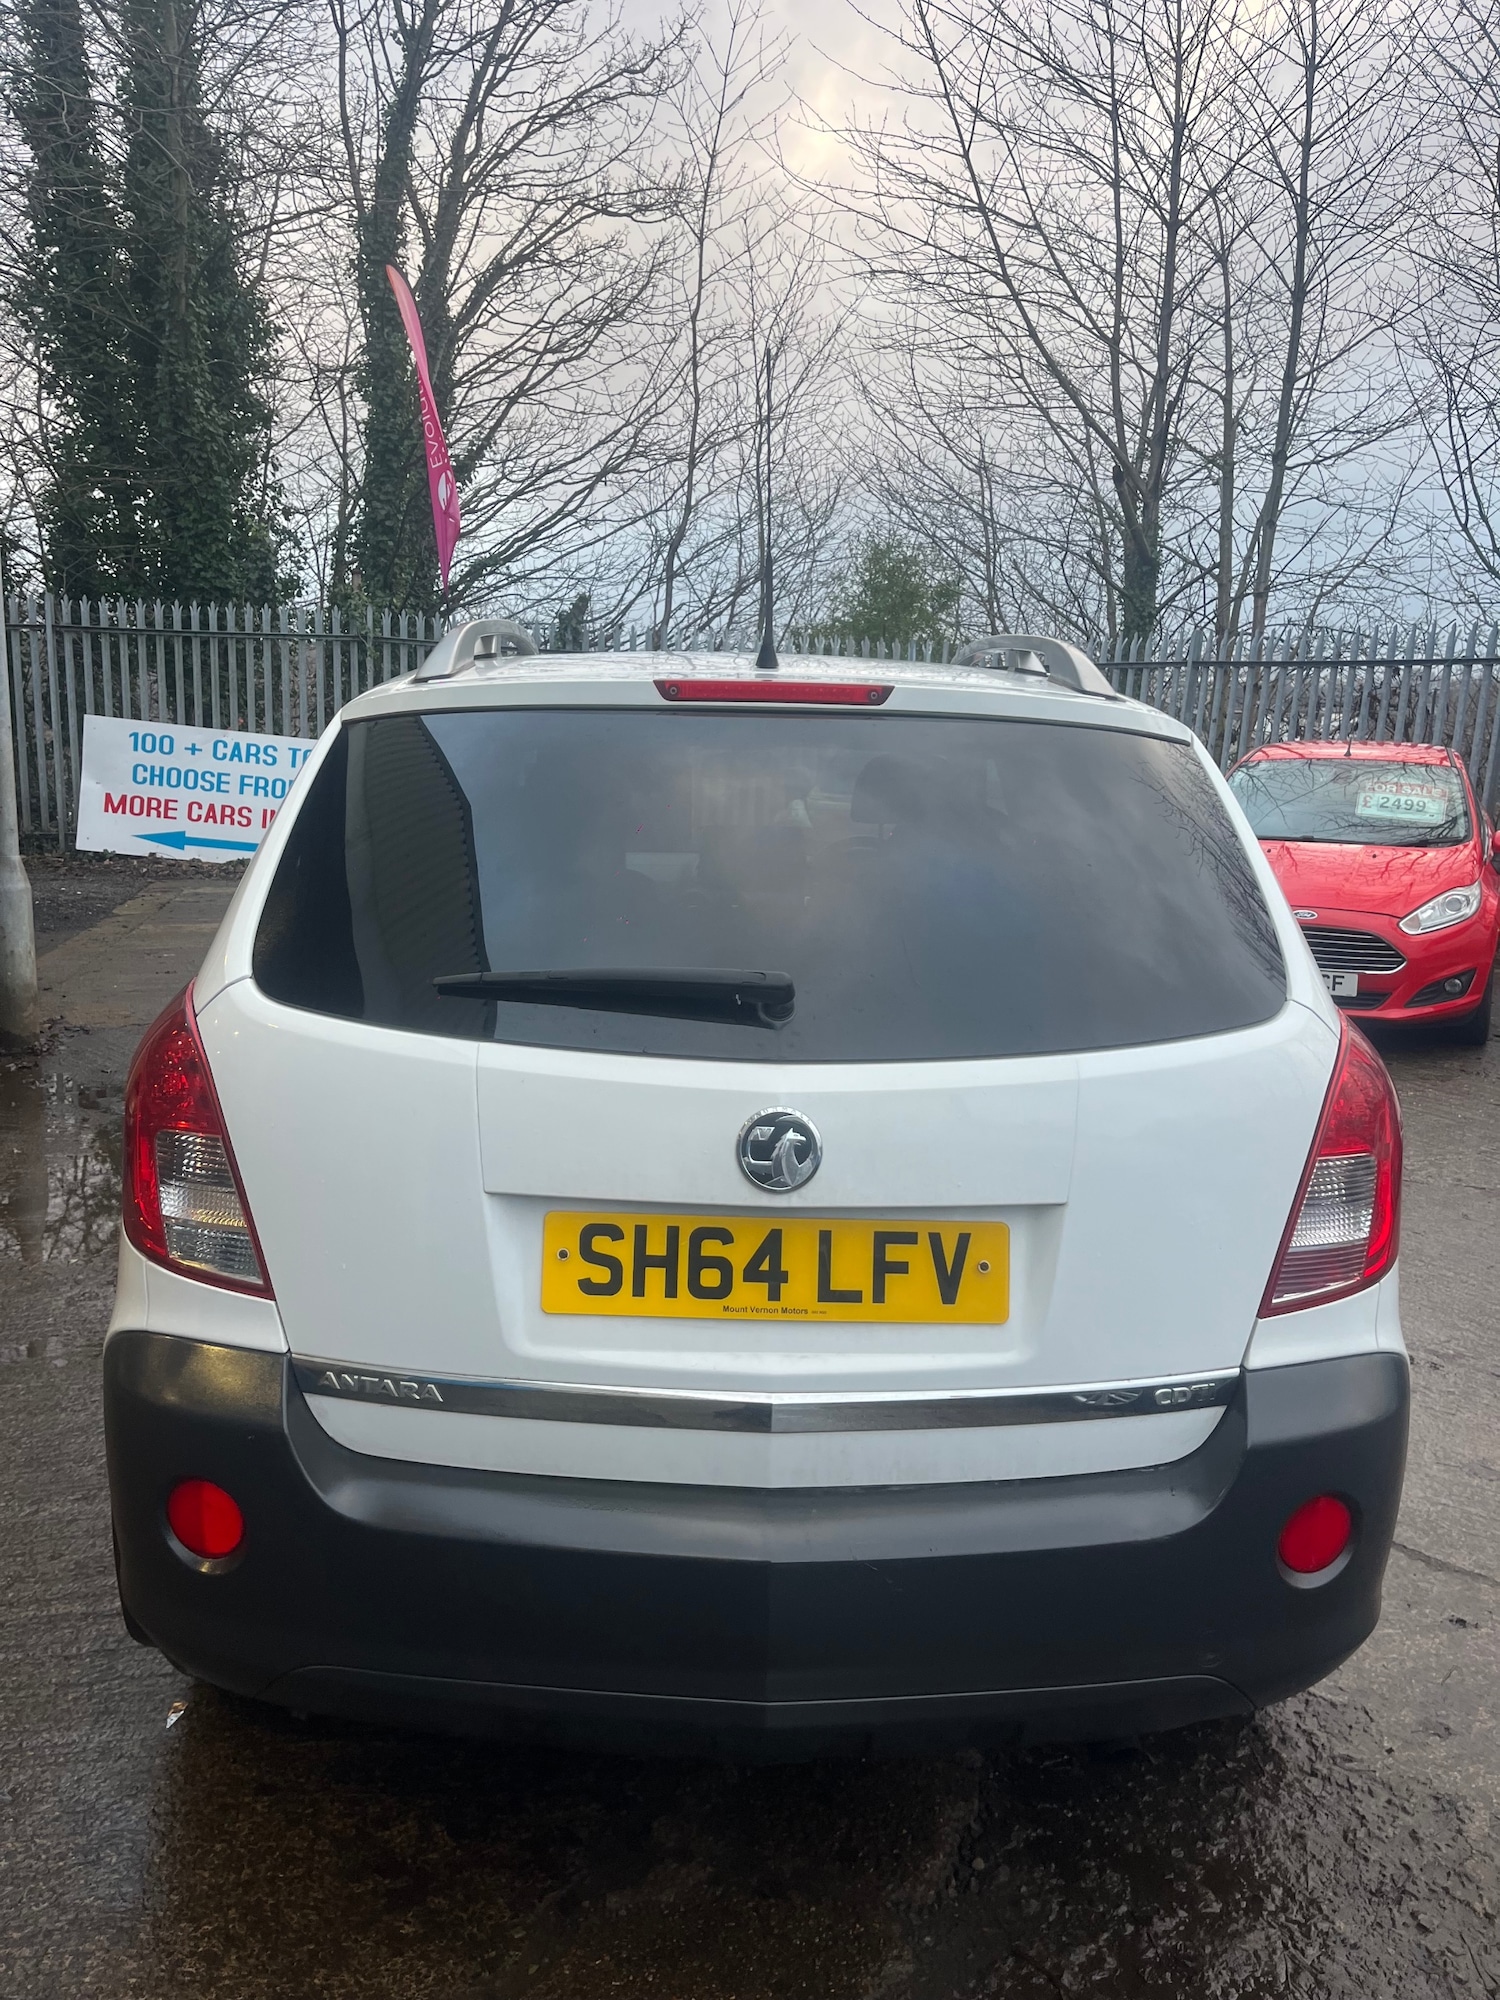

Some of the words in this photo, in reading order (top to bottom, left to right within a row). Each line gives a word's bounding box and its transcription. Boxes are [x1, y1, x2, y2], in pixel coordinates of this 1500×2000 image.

[128, 731, 175, 755] 100
[184, 742, 203, 756] +
[212, 739, 278, 767] CARS
[132, 763, 230, 794] CHOOSE
[239, 774, 294, 799] FRO
[1367, 782, 1397, 793] FOR
[1401, 785, 1443, 797] SALE
[103, 792, 178, 820] MORE
[187, 801, 253, 828] CARS
[1379, 797, 1427, 813] 2499
[577, 1222, 789, 1302] SH64
[817, 1229, 972, 1305] LFV
[722, 1305, 748, 1313] Mount
[750, 1306, 779, 1314] Vernon
[780, 1307, 809, 1315] Motors
[318, 1371, 444, 1402] ANTARA
